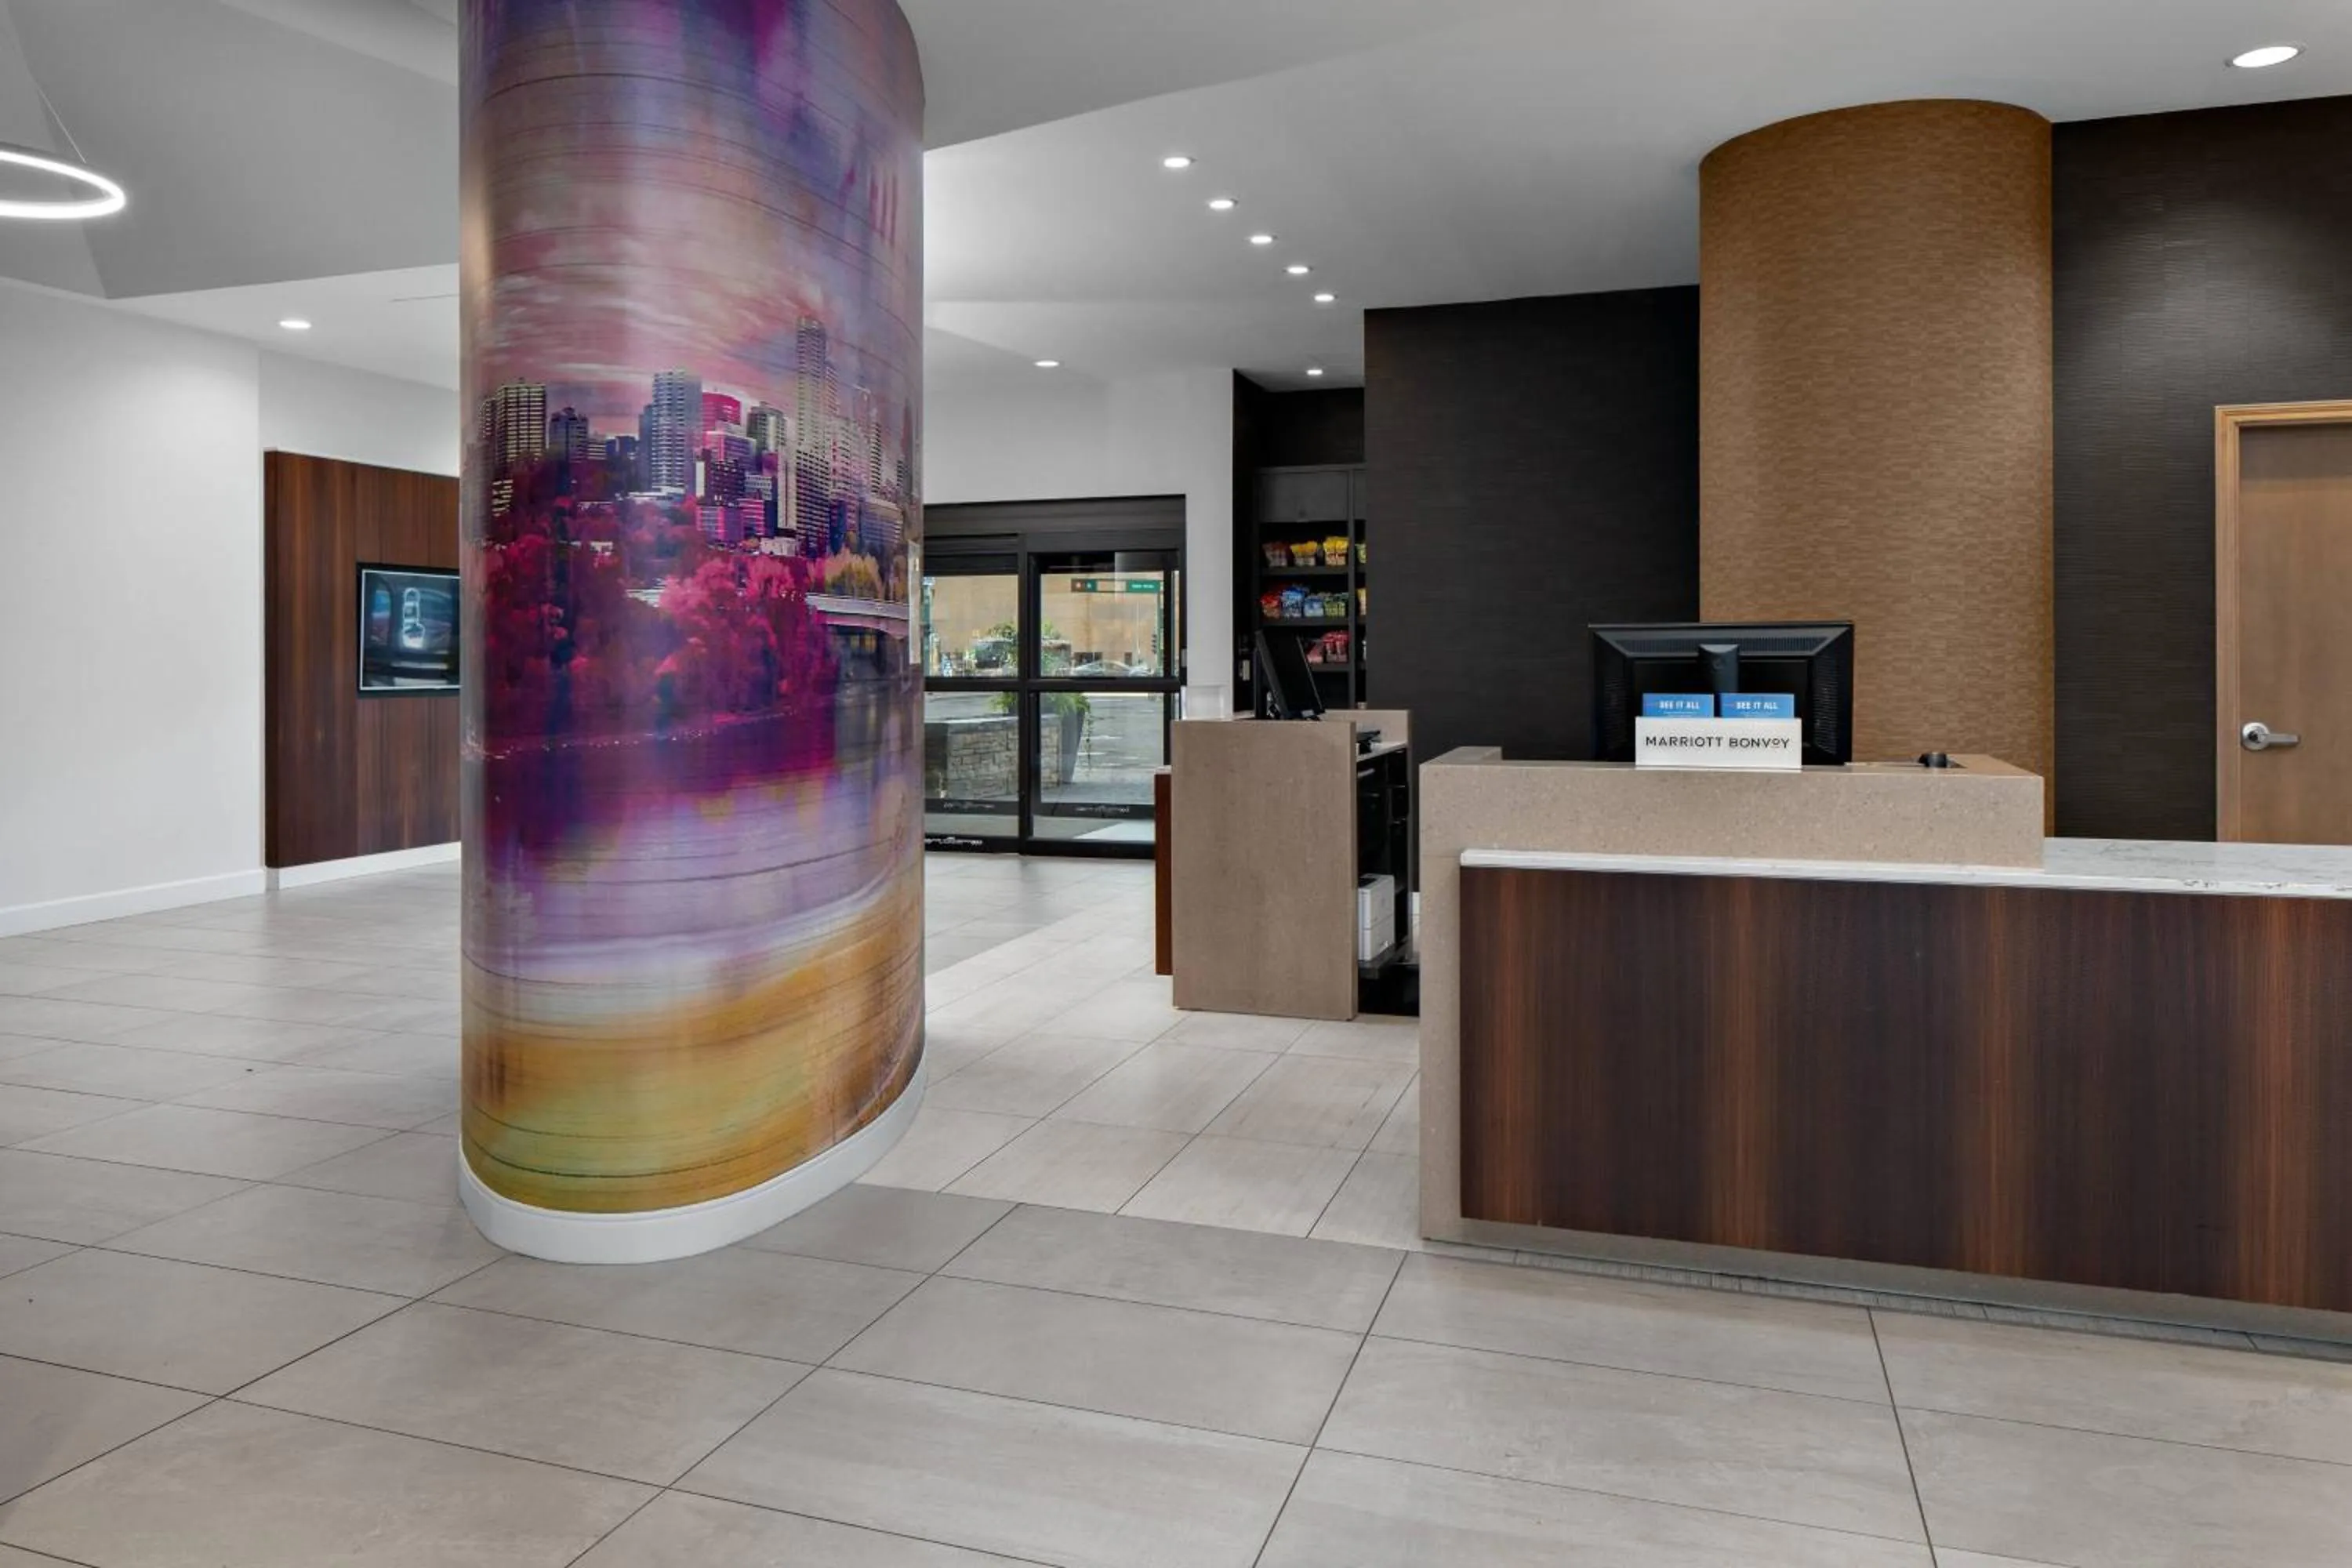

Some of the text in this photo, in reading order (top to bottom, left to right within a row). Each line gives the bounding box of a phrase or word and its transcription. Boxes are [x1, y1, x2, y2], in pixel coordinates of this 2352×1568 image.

[1659, 700, 1700, 710] SEE IT ALL
[1736, 701, 1778, 710] SEE IT ALL
[1646, 735, 1791, 749] MARRIOTT BONVOY
